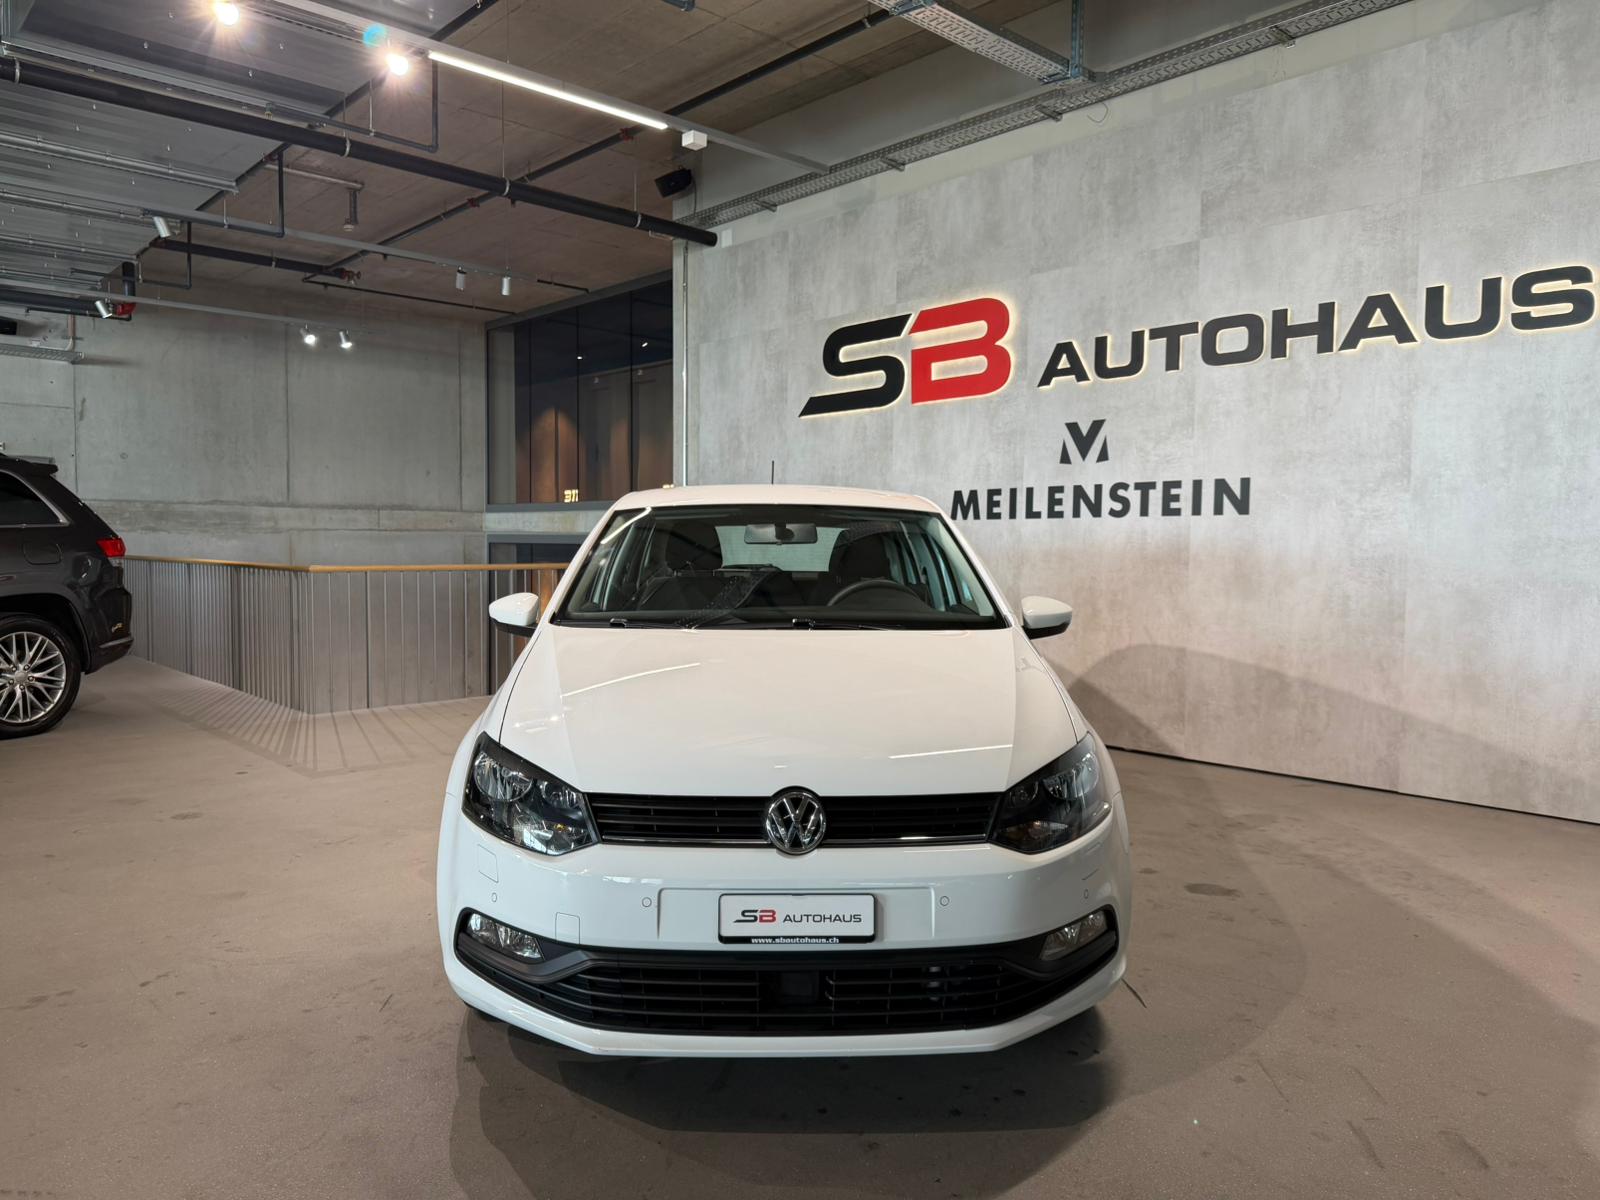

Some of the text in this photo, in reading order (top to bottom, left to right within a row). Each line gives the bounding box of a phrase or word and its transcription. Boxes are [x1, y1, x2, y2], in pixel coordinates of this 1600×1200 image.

[798, 265, 1596, 418] SB AUTOHAUS
[950, 477, 1251, 521] MEILENSTEIN
[734, 909, 862, 923] SB AUTOHAUS
